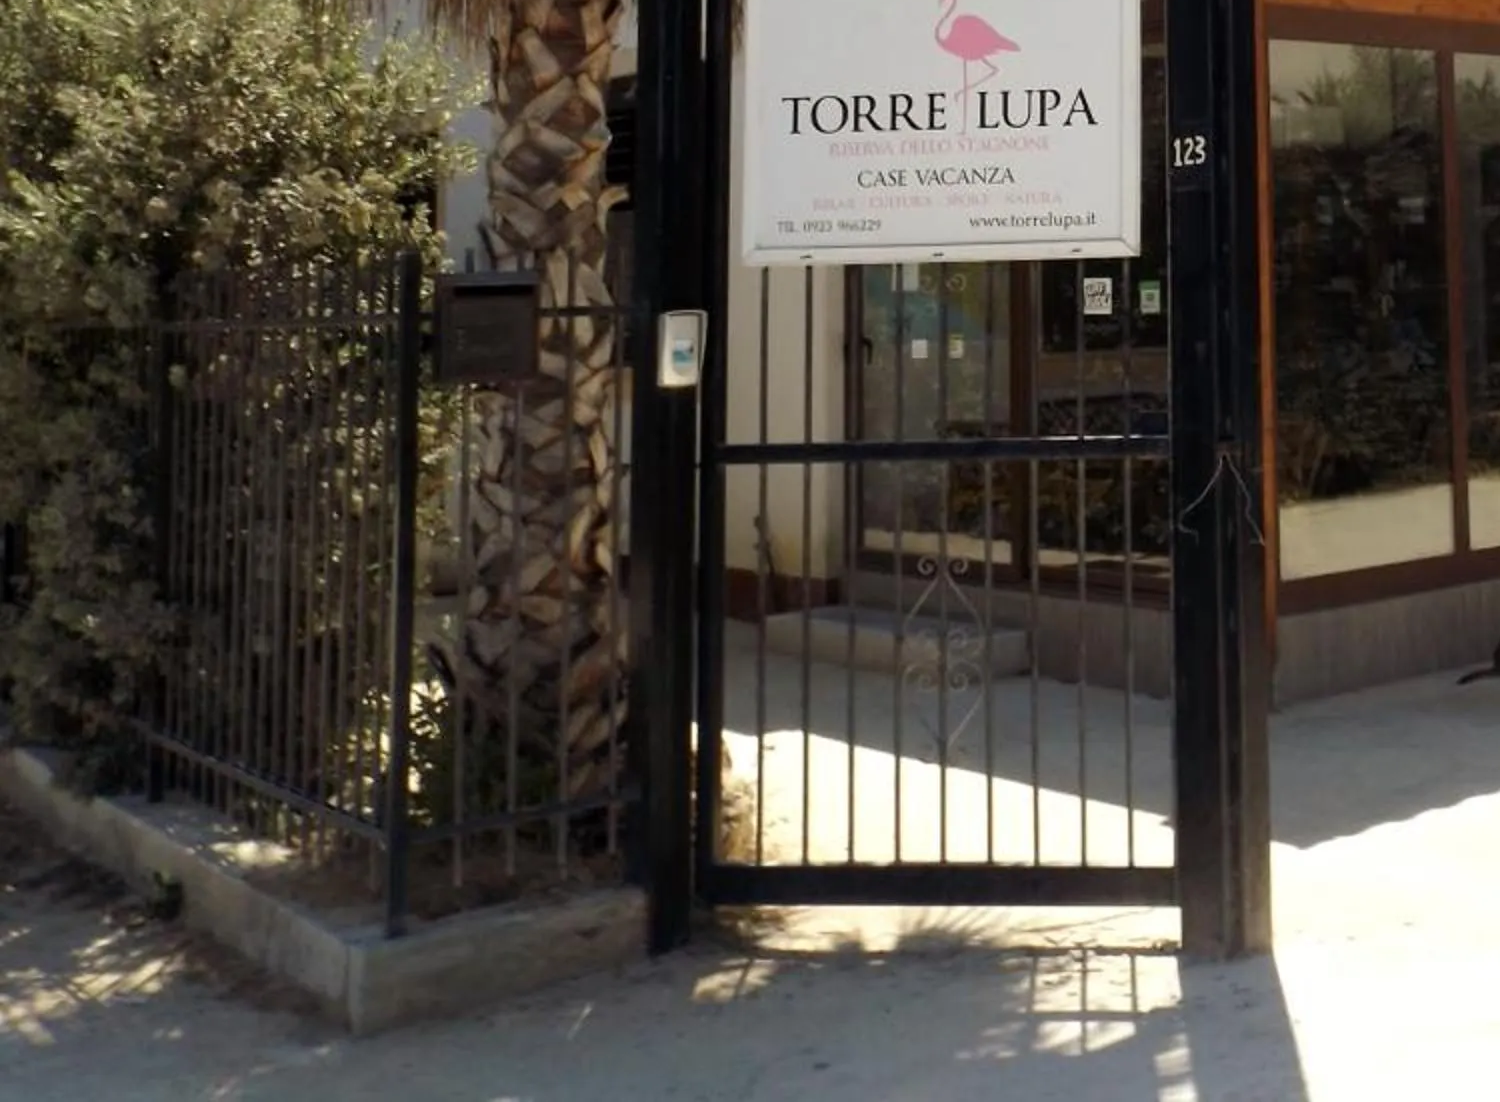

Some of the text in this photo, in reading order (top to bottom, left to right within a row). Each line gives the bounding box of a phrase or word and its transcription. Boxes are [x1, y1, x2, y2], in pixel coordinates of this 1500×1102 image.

[782, 87, 1099, 134] TORRE LUPA
[900, 138, 950, 155] DELLO
[1173, 135, 1206, 167] 123
[857, 167, 1015, 188] CASE VACANZA
[969, 211, 1097, 230] www.torrelupa.it
